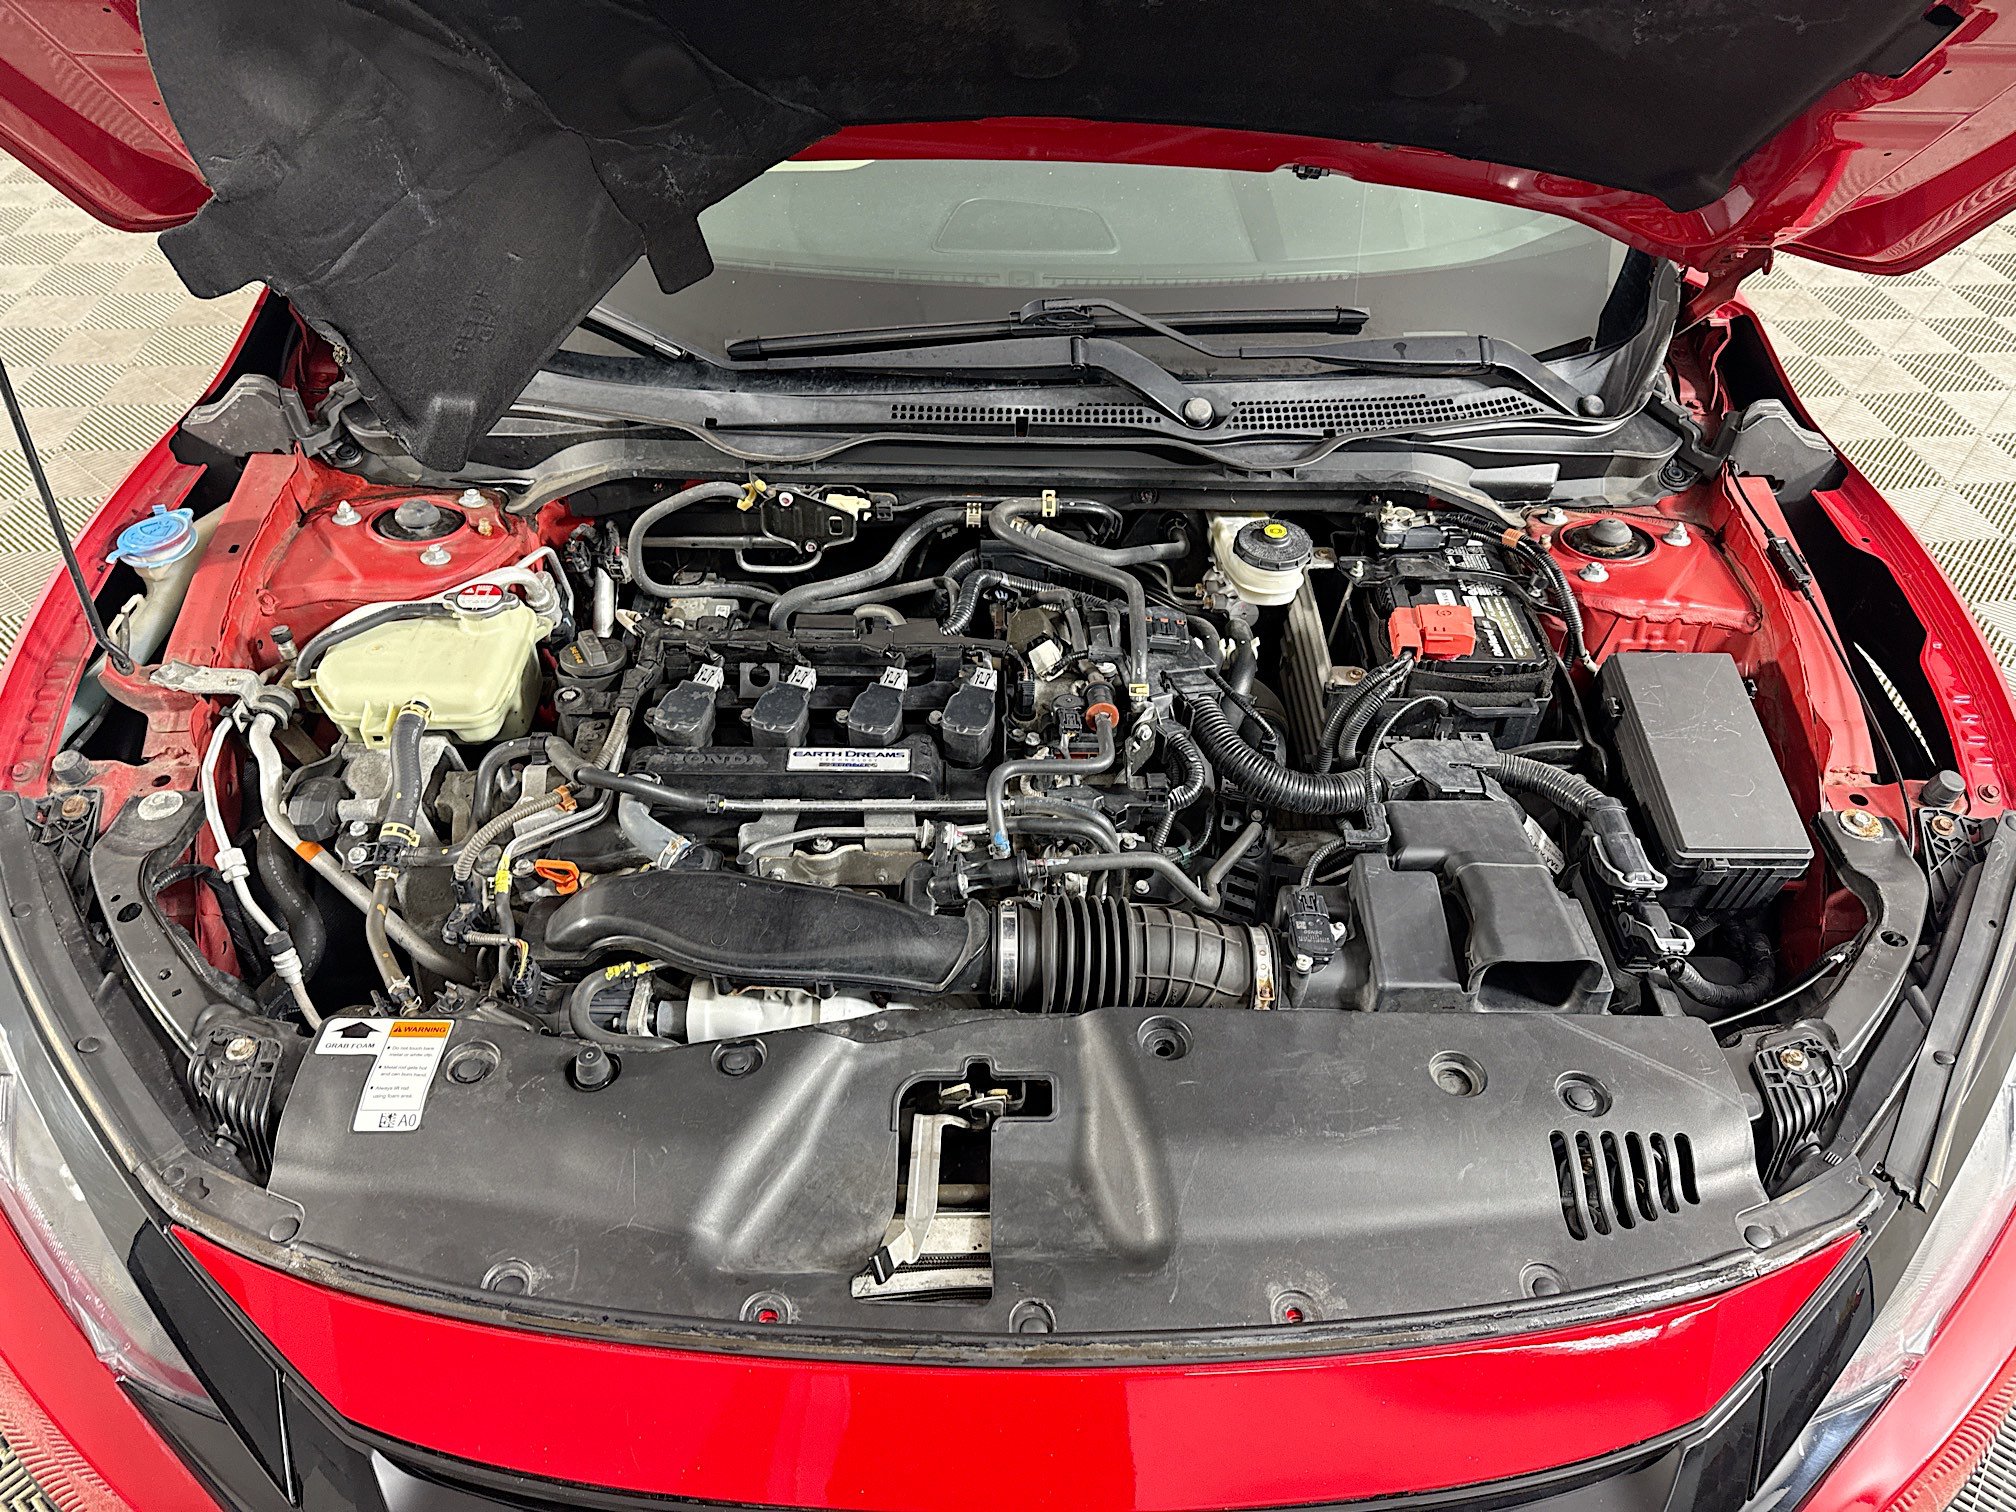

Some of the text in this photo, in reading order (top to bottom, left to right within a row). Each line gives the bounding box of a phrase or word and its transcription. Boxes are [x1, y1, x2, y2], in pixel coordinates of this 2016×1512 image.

[668, 752, 768, 765] HONDA
[845, 750, 905, 758] DREAMS
[397, 1113, 416, 1127] A0
